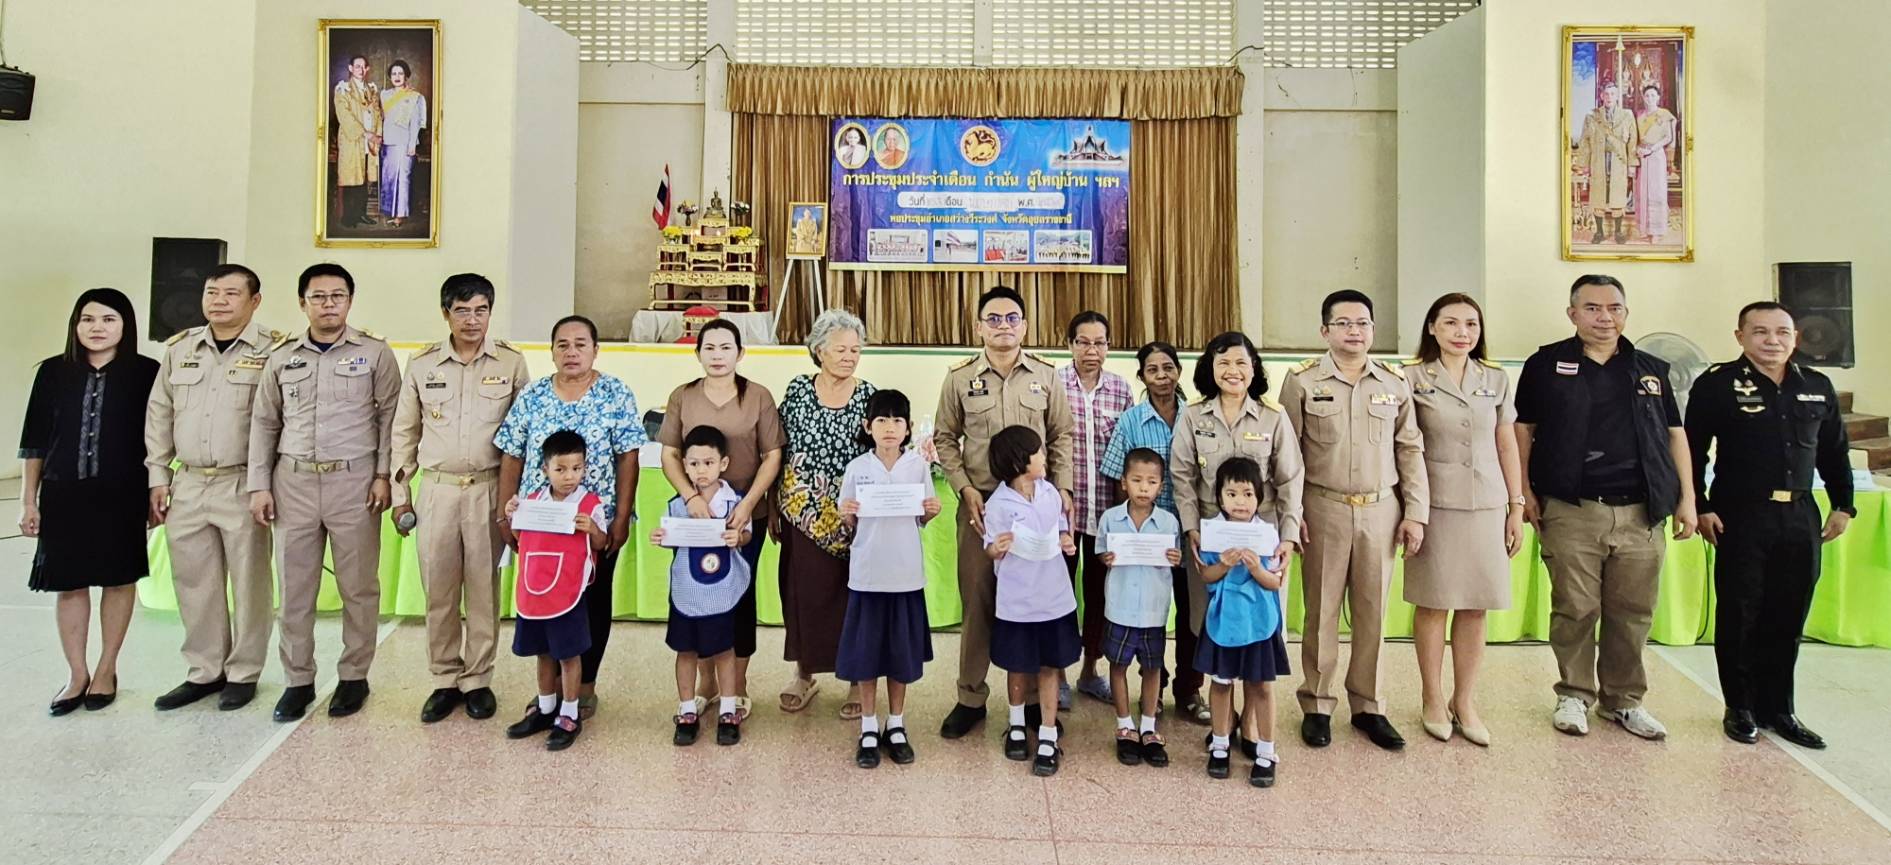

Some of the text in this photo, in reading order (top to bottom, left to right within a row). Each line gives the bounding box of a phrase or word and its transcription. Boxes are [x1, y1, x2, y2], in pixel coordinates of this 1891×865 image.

[843, 169, 1120, 191] การประชุมประจำเดือน กำนัน ผู้ใหญ่บ้าน ฯลฯ
[909, 193, 926, 206] วันที่
